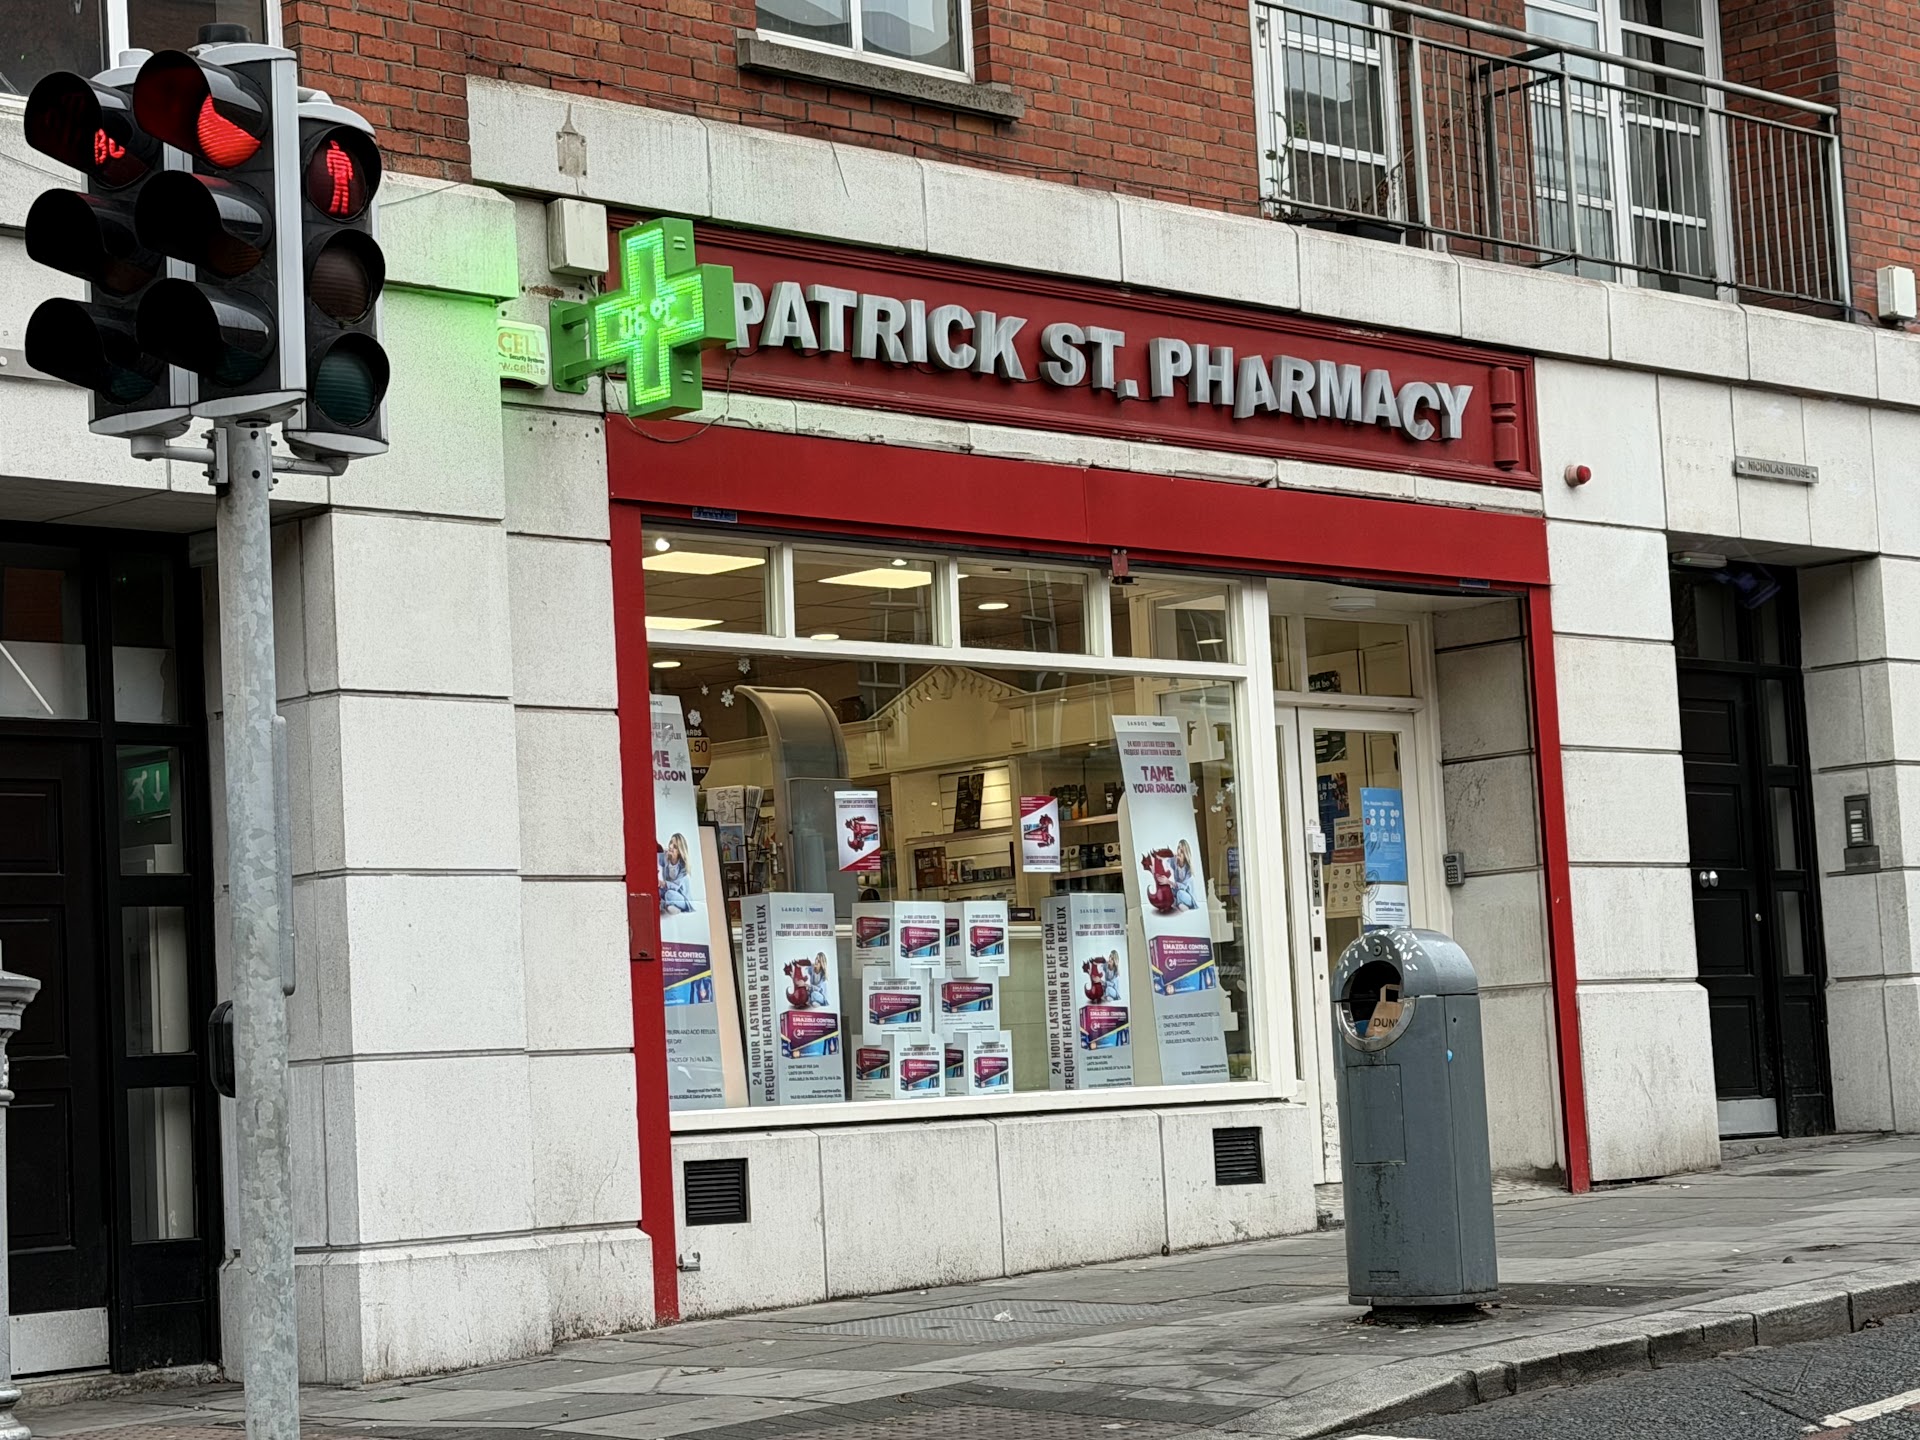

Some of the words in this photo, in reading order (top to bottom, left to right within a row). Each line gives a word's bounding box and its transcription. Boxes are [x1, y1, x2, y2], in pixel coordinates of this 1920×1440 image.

[497, 331, 546, 358] CELL
[498, 361, 546, 376] w.cell.ie
[732, 281, 1028, 381] PATRICK
[1039, 322, 1139, 400] ST.
[1149, 336, 1474, 441] PHARMACY
[1747, 460, 1785, 475] NICHOLAS
[1785, 467, 1811, 479] HOUSE
[652, 750, 671, 768] ME
[690, 740, 708, 753] .50
[652, 770, 687, 781] RAGON
[1141, 766, 1175, 782] TAME
[1132, 783, 1155, 794] YOUR
[1156, 783, 1187, 794] DRAGON
[1313, 859, 1321, 898] PUSH
[744, 923, 756, 952] FROM
[755, 904, 768, 944] REFLUX
[1044, 923, 1056, 951] FROM
[1056, 906, 1068, 943] REFLUX
[661, 950, 677, 958] ZOLE
[678, 951, 707, 959] CONTROL
[758, 946, 769, 971] ACID
[1058, 945, 1069, 968] ACID
[1168, 958, 1177, 967] 24
[746, 956, 758, 991] RELIEF
[760, 974, 770, 982] &
[1046, 953, 1058, 987] RELIEF
[748, 993, 760, 1038] LASTING
[760, 985, 773, 1046] HEARTBURN
[1047, 989, 1059, 1030] LASTING
[1060, 981, 1073, 1039] HEARTBURN
[750, 1040, 761, 1068] HOUR
[1049, 1032, 1061, 1059] HOUR
[752, 1071, 763, 1086] 24
[763, 1050, 776, 1102] FREQUENT
[1051, 1061, 1062, 1075] 24
[1063, 1042, 1075, 1091] FREQUENT
